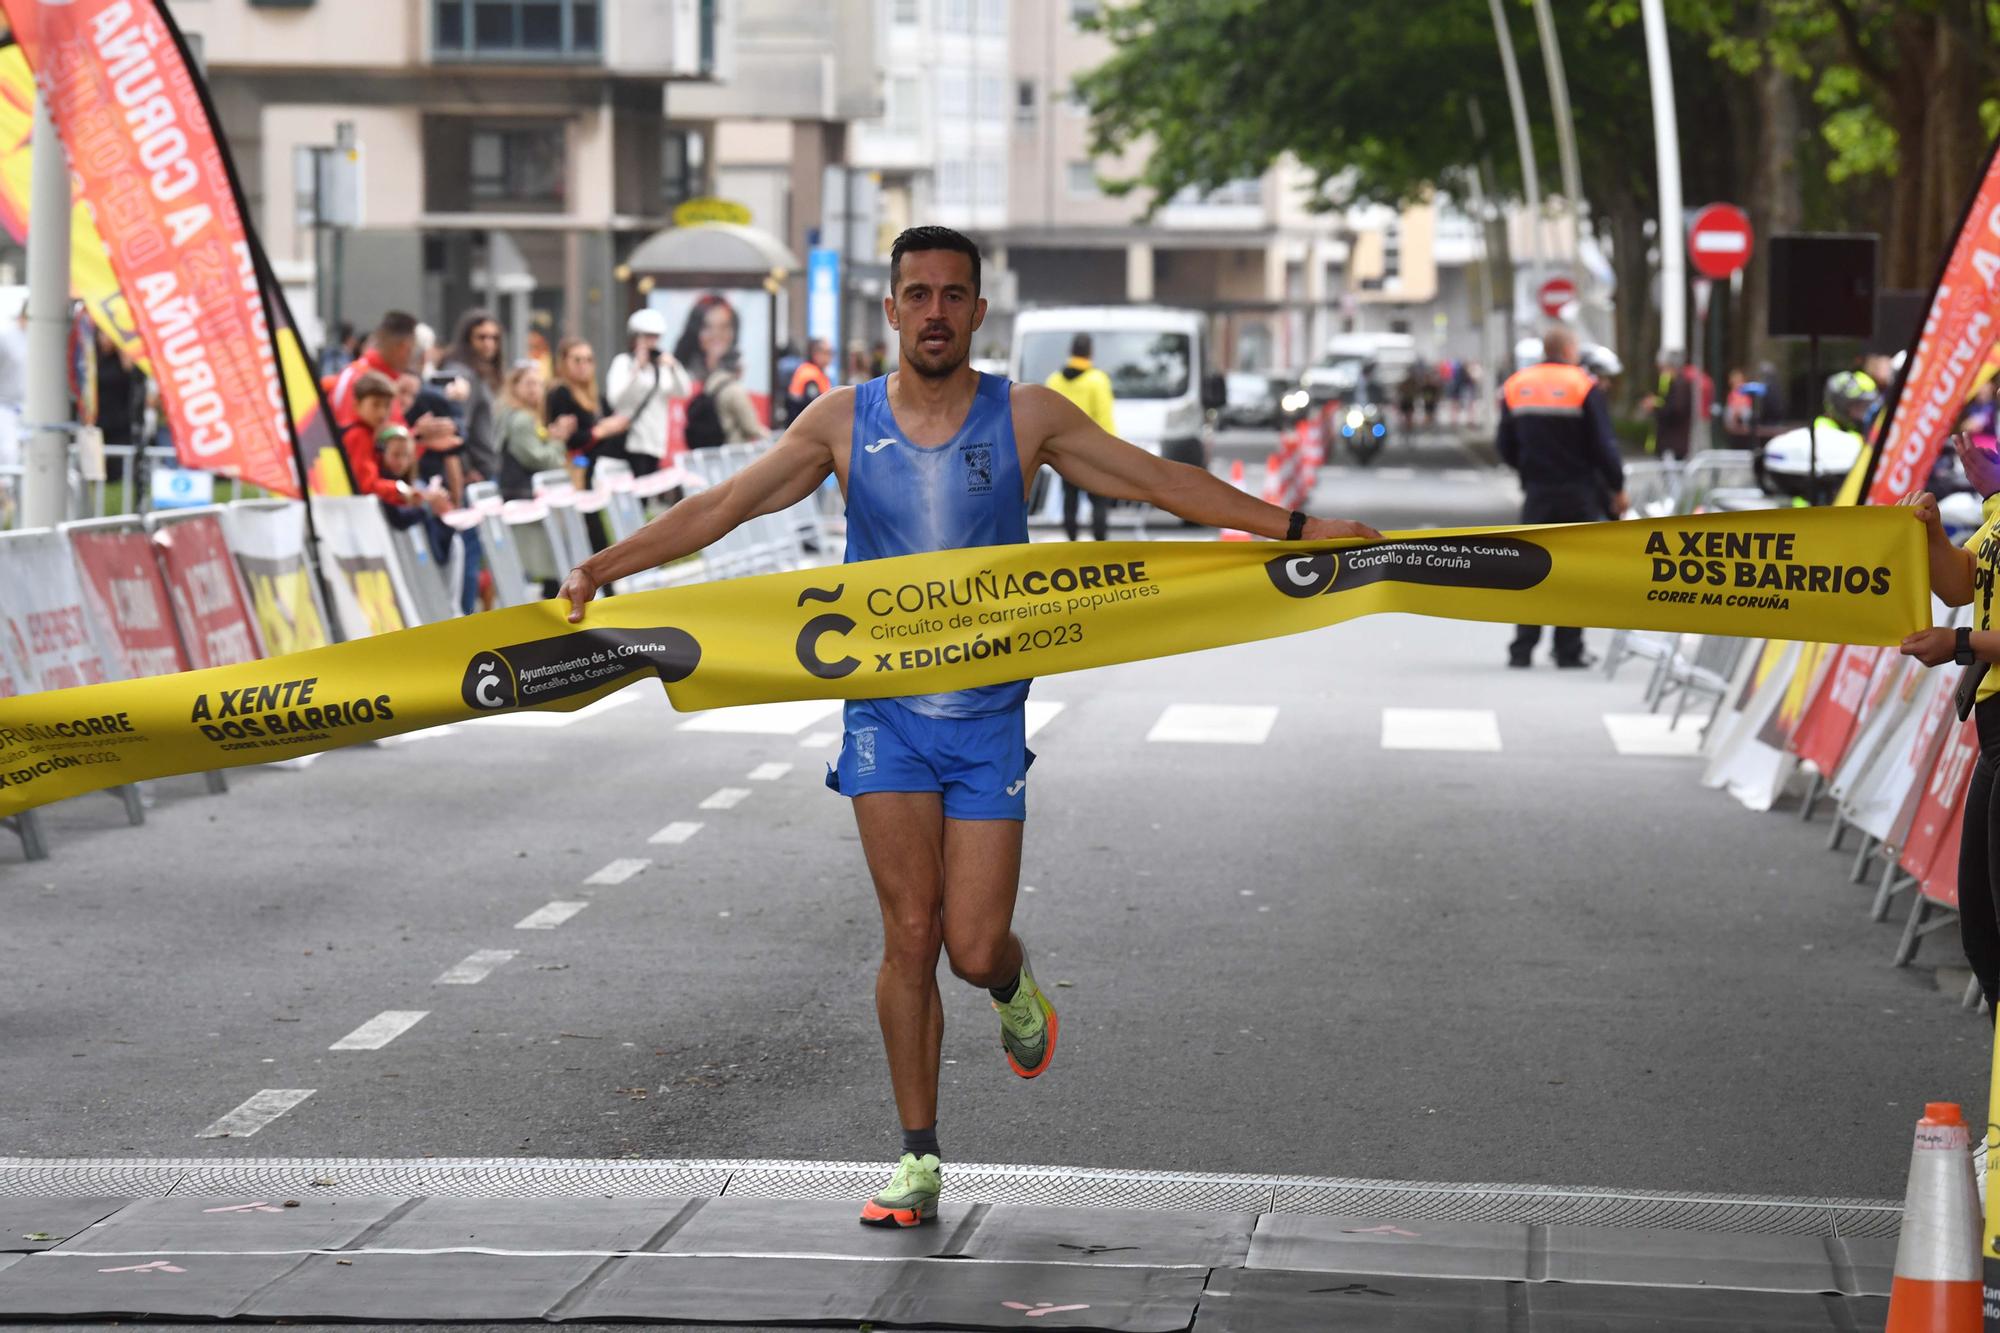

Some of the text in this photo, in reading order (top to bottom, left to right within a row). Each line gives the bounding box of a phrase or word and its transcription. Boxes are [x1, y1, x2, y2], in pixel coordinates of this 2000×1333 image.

[1348, 552, 1471, 570] Concello da Coruña
[1440, 543, 1458, 553] de
[1461, 545, 1471, 554] A
[1473, 546, 1520, 557] Coruña
[1645, 532, 1796, 560] A XENTE
[1651, 558, 1892, 596] DOS BARRIOS
[870, 583, 1160, 640] Circuíto de carreiras populares
[1647, 590, 1790, 610] CORRE NA CORUÑA
[519, 642, 667, 682] Ayuntamiento de A Coruña
[875, 623, 1084, 673] X EDICIÓN 2023
[522, 661, 625, 695] Concello da Coruña
[191, 677, 318, 723] A XENTE
[199, 694, 394, 742] DOS BARRIOS
[219, 739, 260, 751] CORRE
[10, 753, 81, 785] EDICIÓN
